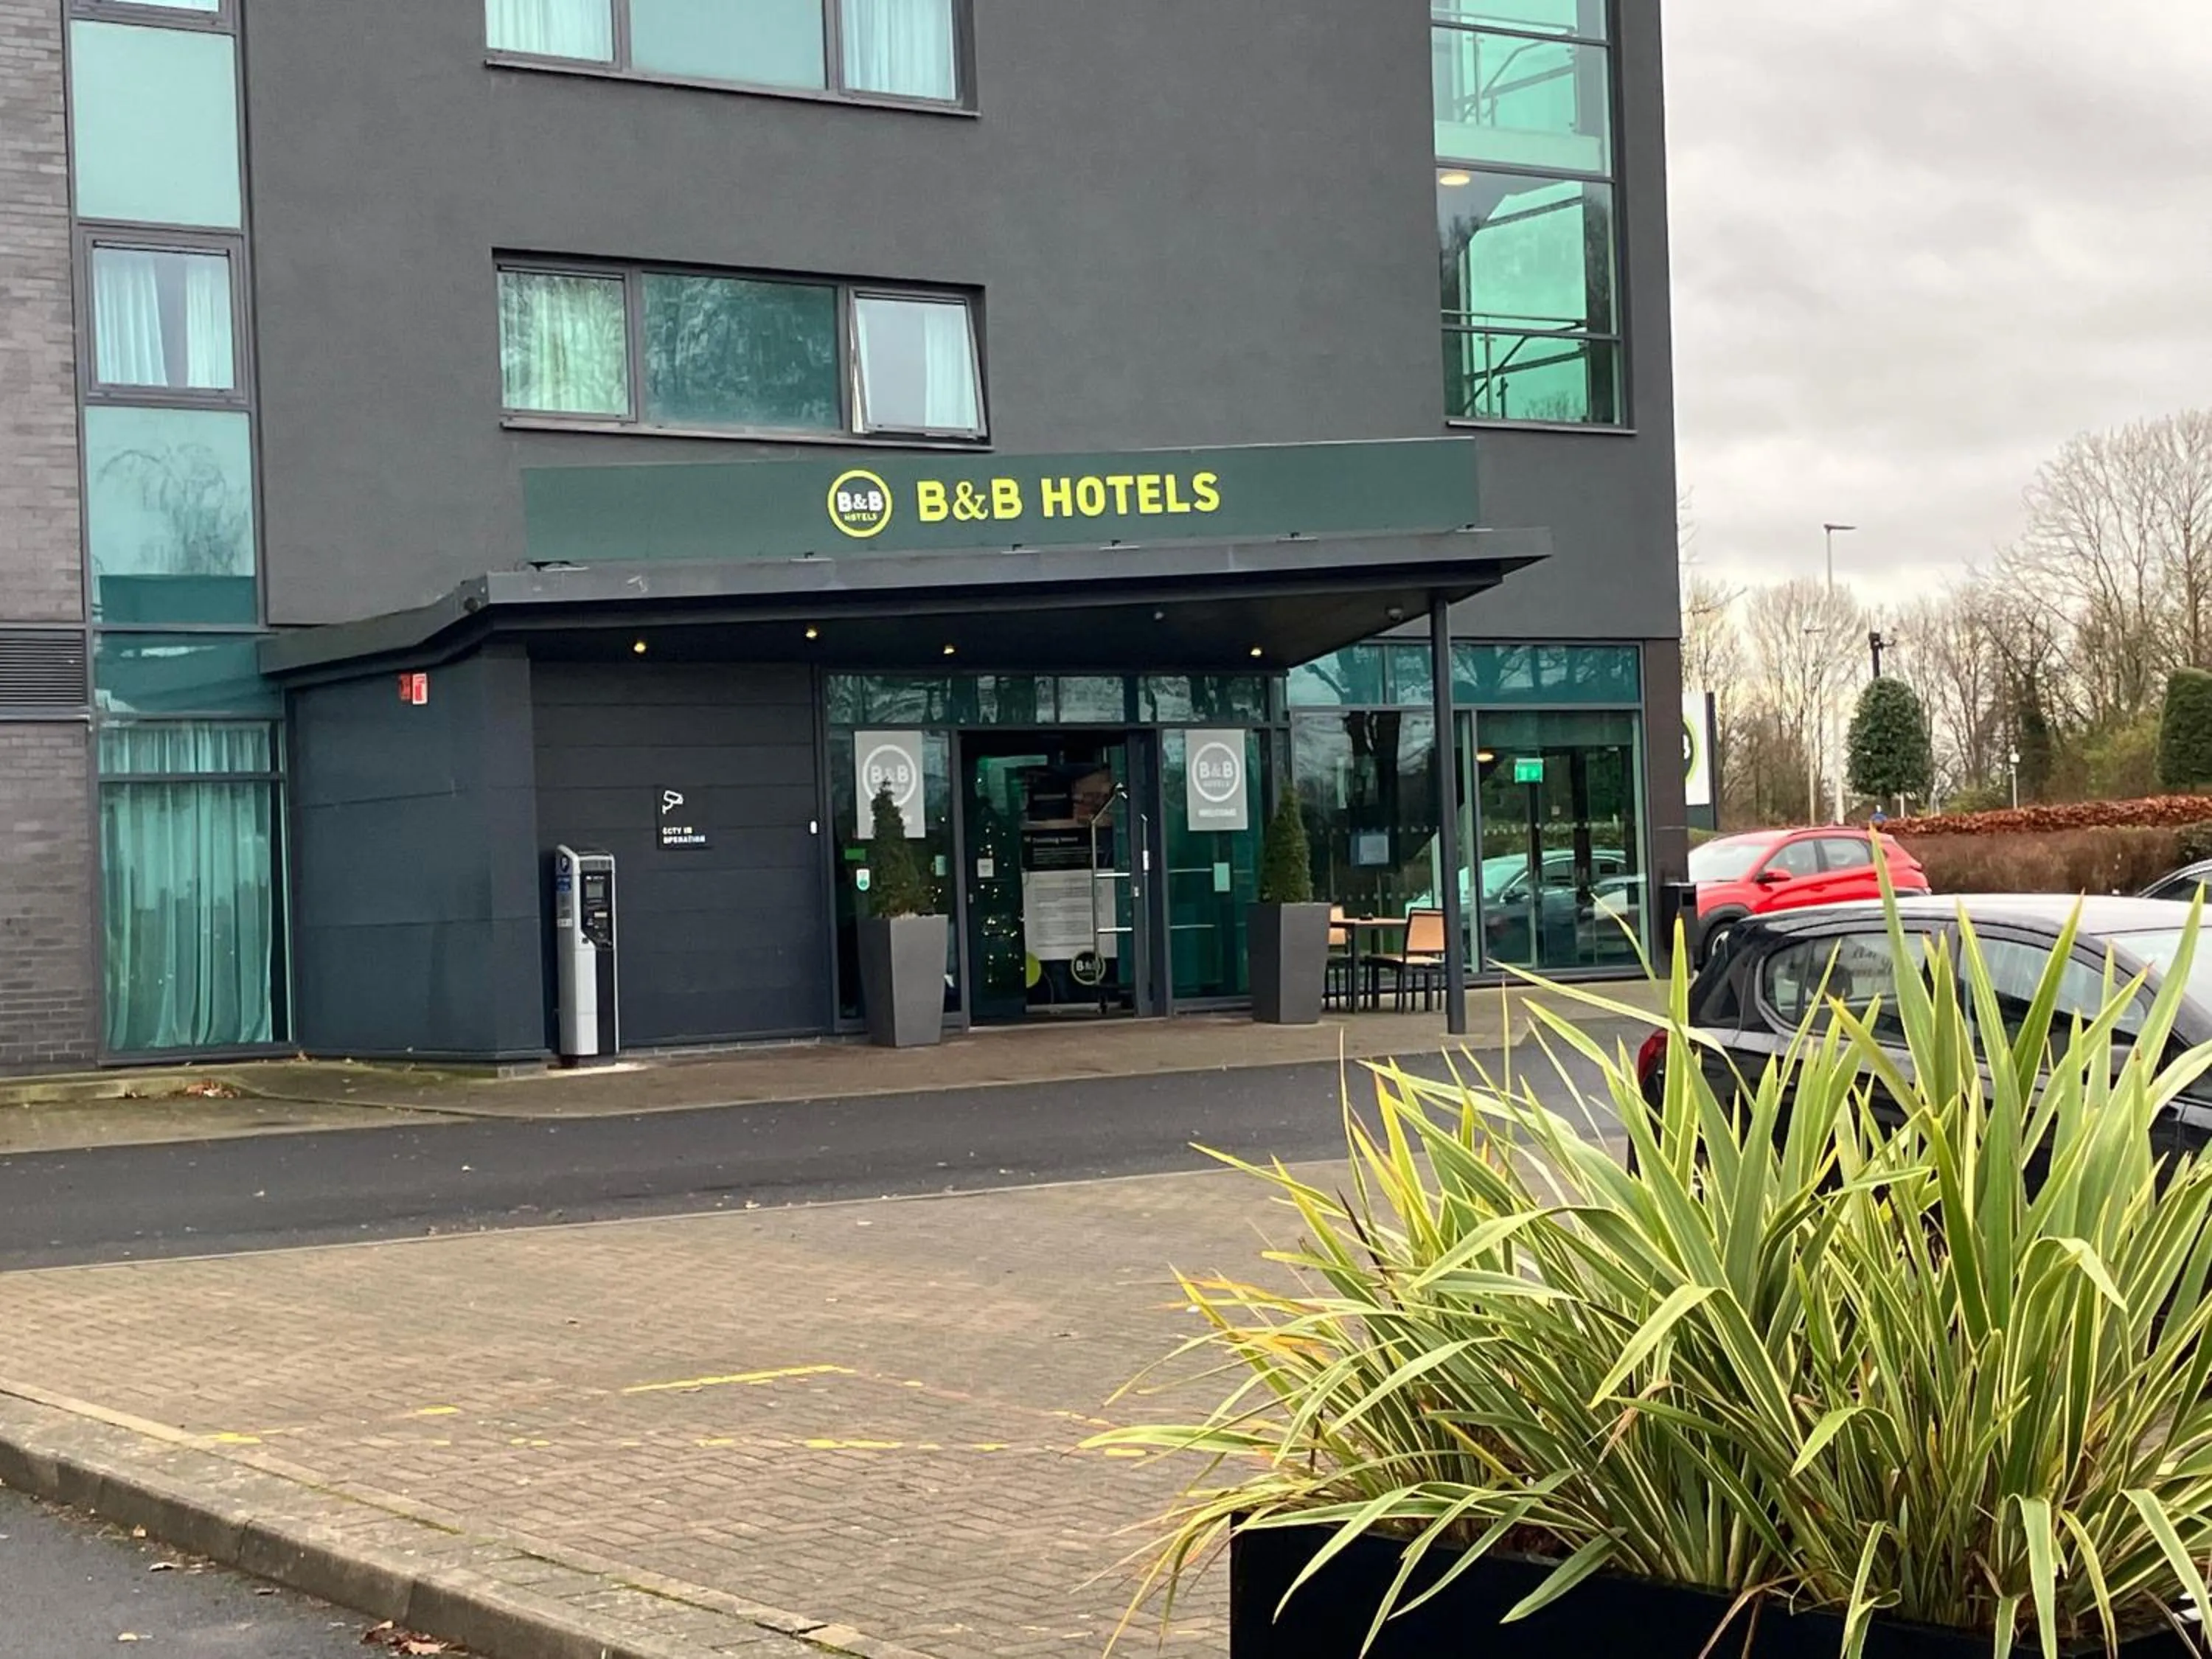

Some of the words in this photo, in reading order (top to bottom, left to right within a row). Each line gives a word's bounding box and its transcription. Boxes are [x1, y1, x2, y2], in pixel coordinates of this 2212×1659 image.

[837, 490, 883, 512] B&B
[916, 478, 1023, 522] B&B
[1040, 472, 1220, 518] HOTELS
[844, 512, 877, 521] HOTELS
[1199, 760, 1234, 779] B&B
[662, 827, 682, 835] CCTV
[663, 835, 706, 844] OPERATION
